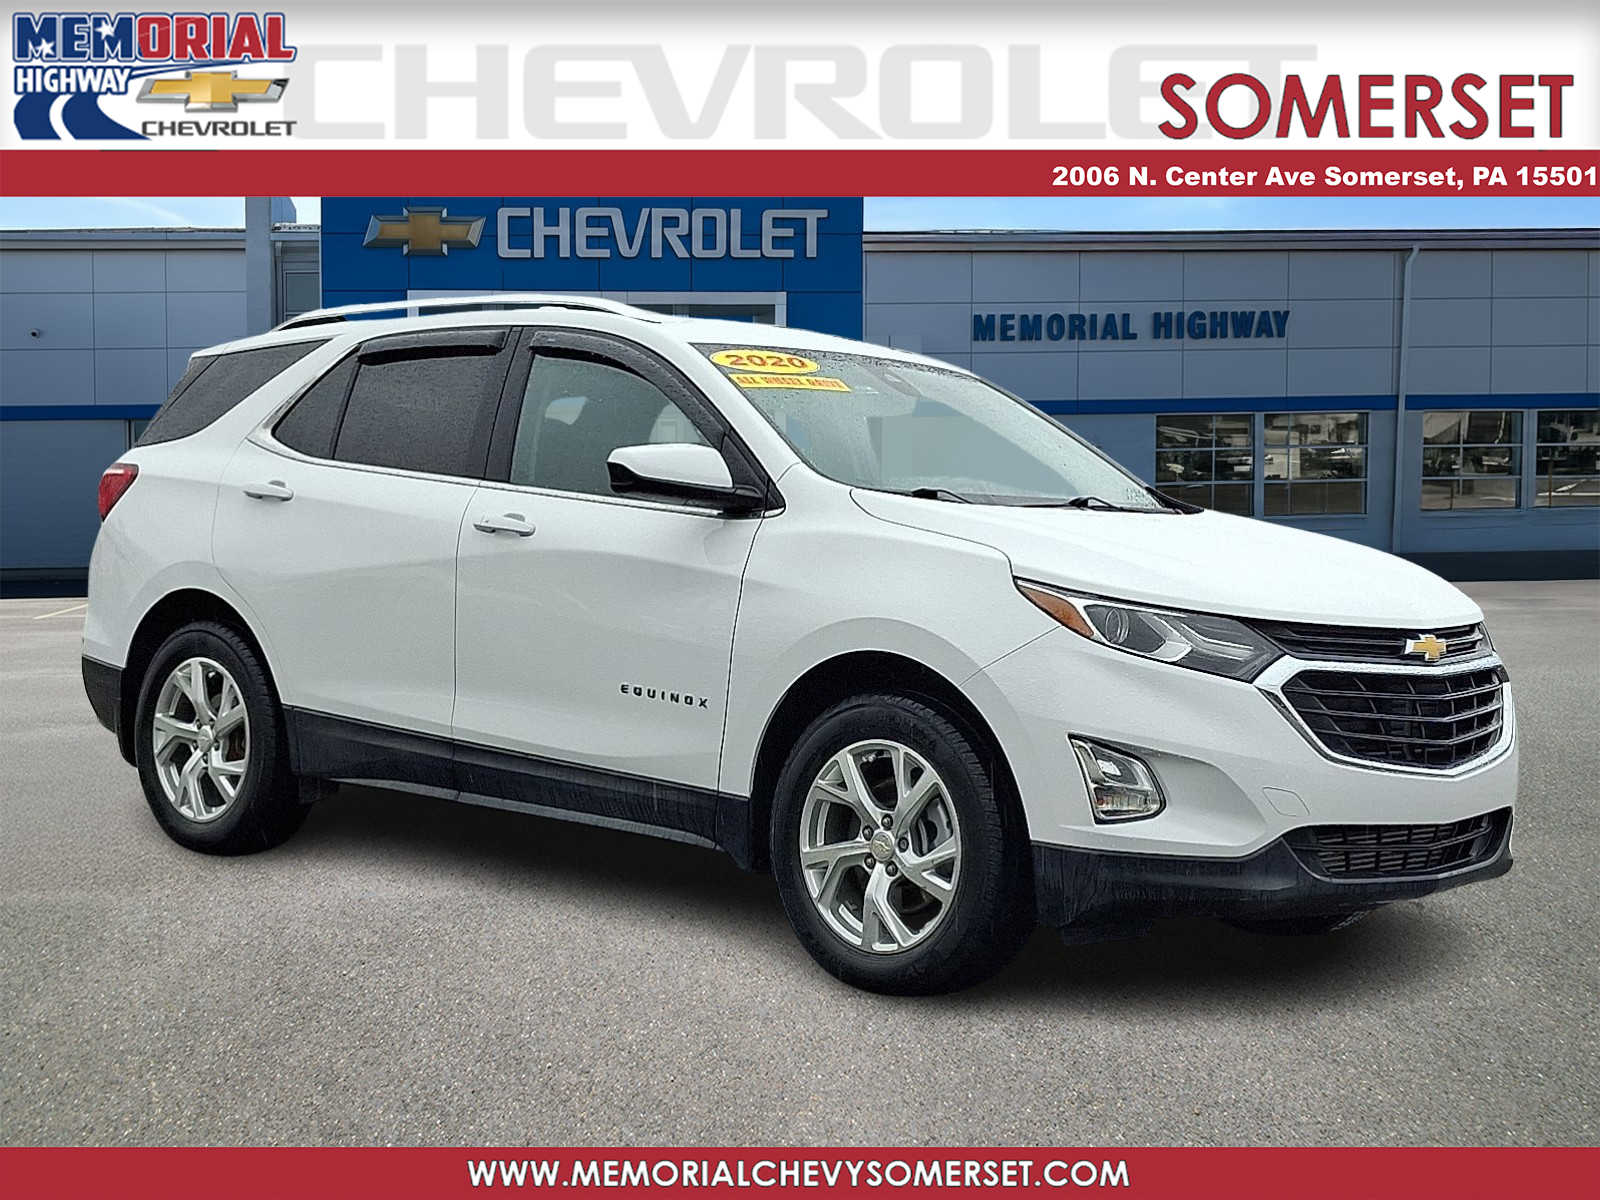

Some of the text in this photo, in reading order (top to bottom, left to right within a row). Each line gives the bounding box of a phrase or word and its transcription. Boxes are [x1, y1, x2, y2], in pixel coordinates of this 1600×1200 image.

[497, 206, 828, 260] CHEVROLET
[972, 309, 1291, 342] MEMORIAL HIGHWAY
[725, 354, 808, 369] 2020
[620, 684, 708, 709] EQUINOX
